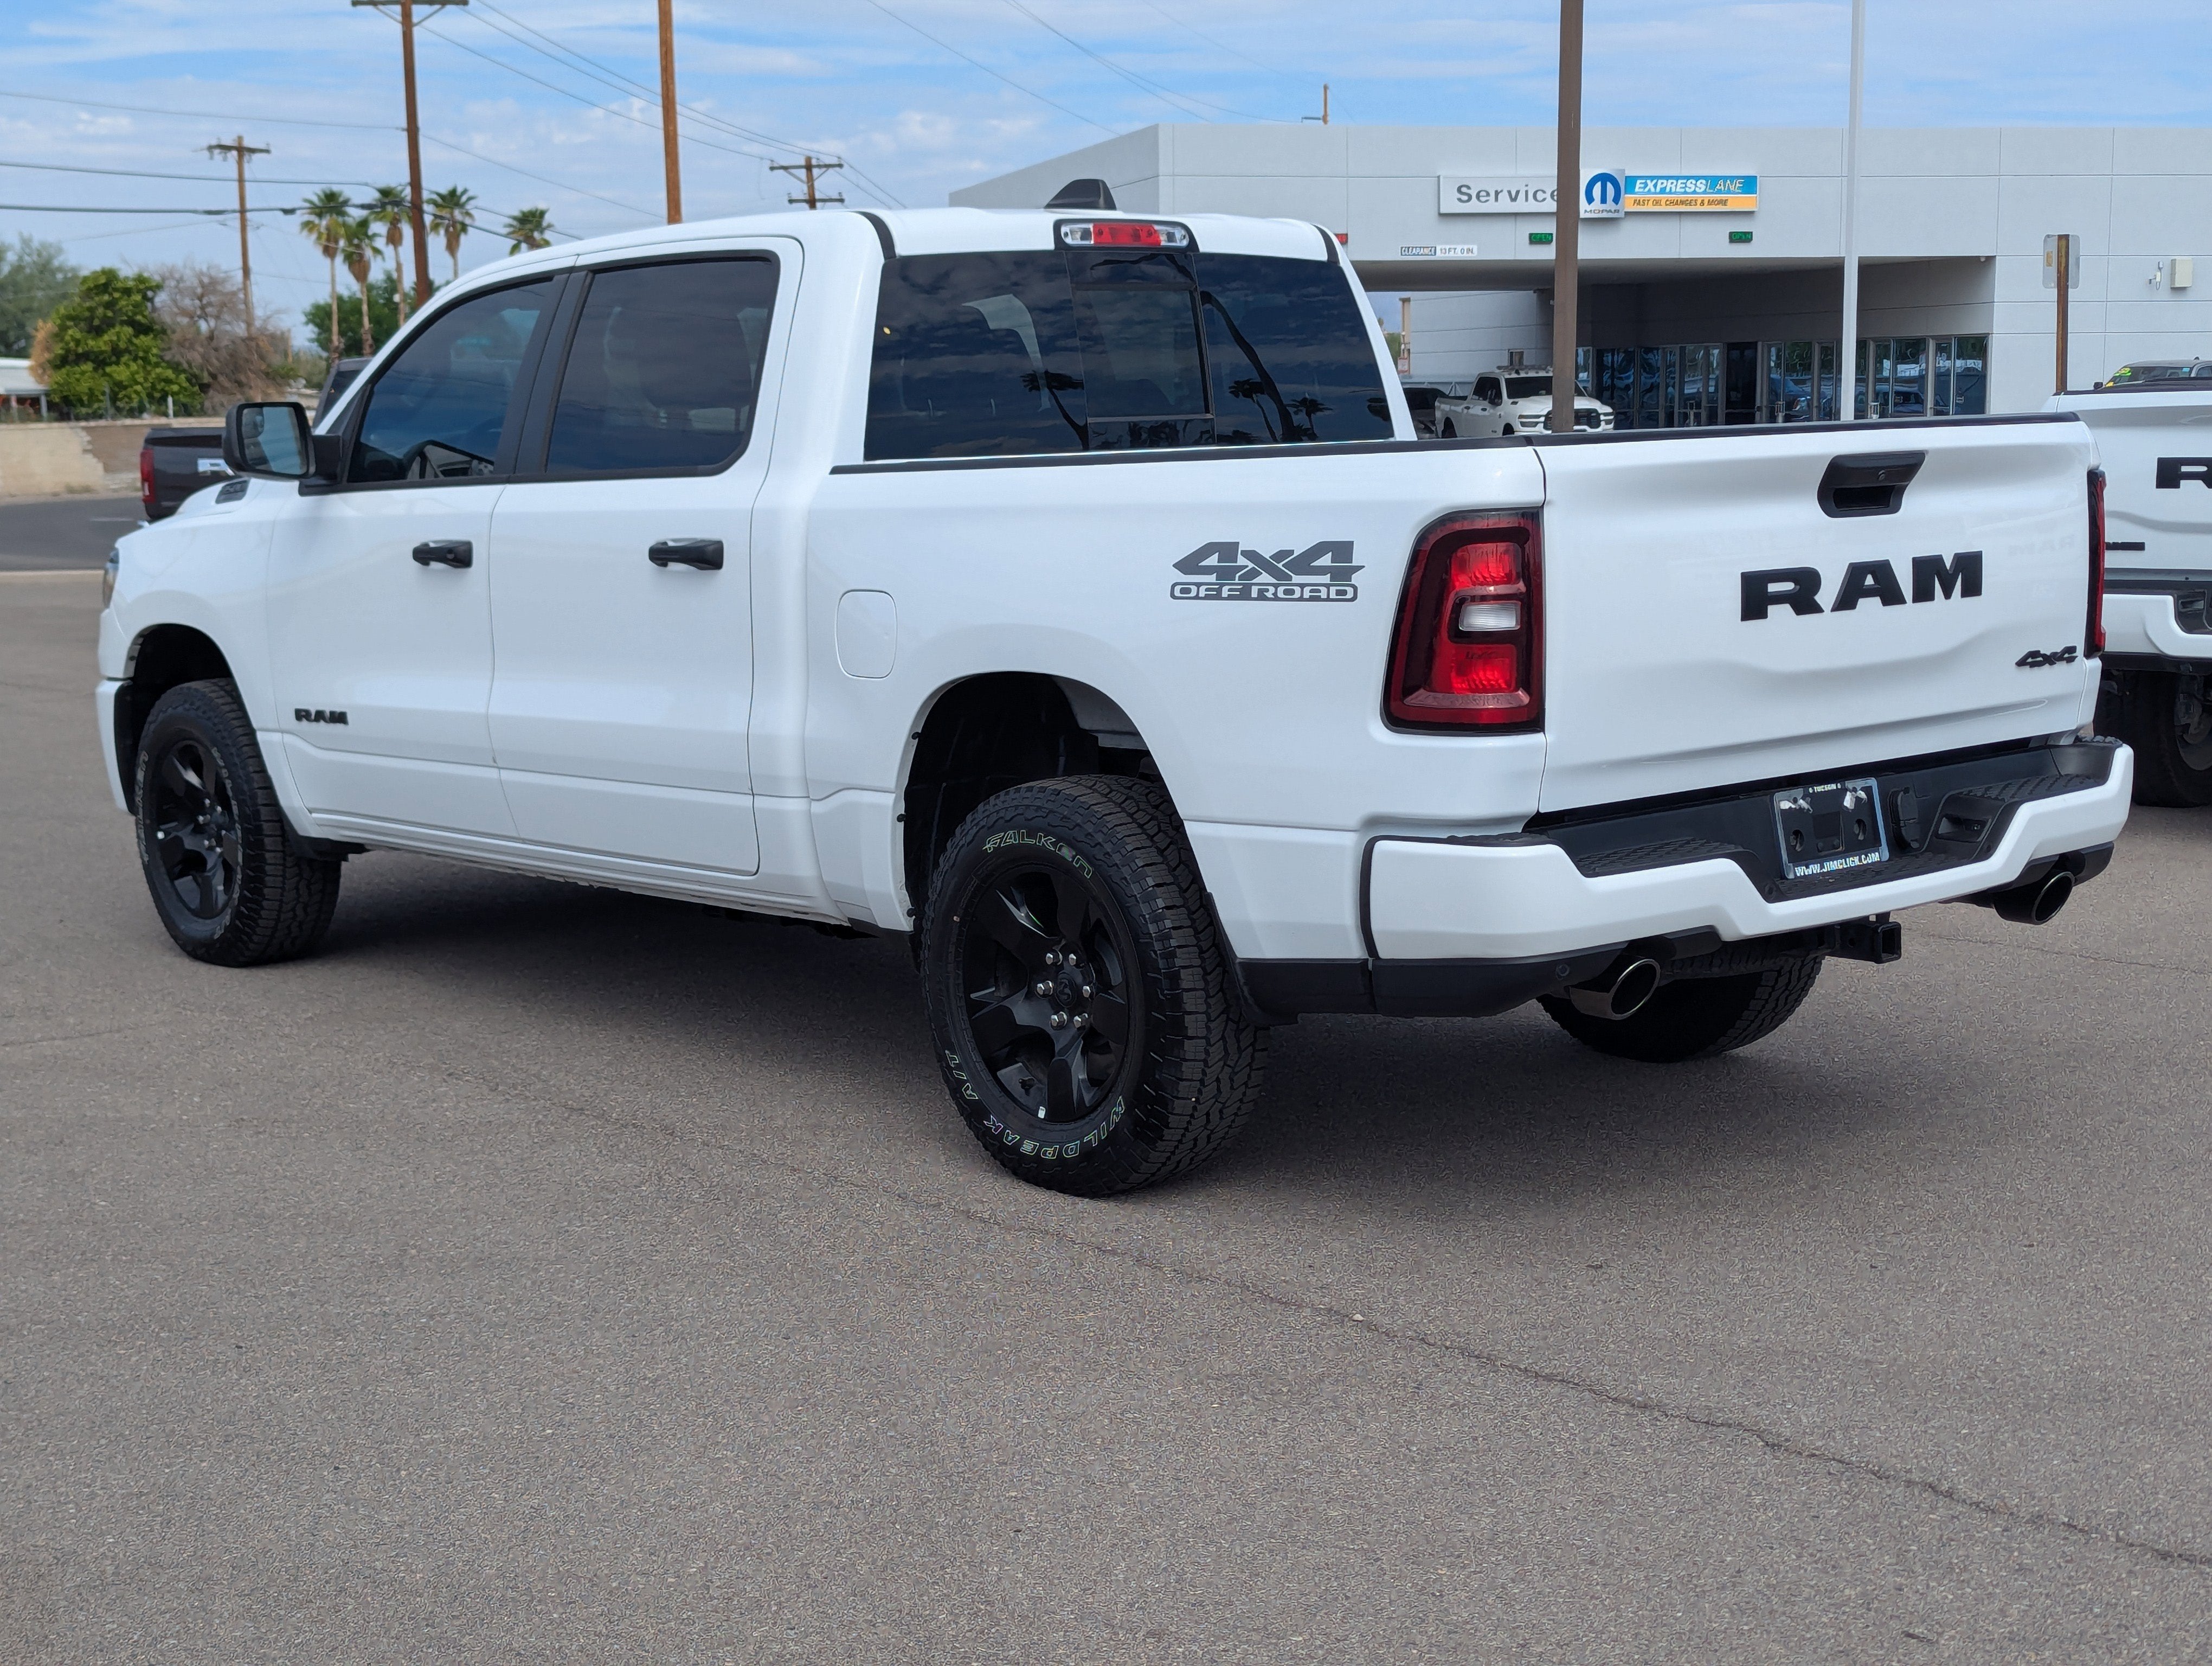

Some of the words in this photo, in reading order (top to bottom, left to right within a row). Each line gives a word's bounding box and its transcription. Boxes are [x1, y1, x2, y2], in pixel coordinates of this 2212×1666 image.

[1174, 585, 1243, 597] OFF
[1251, 586, 1354, 599] ROAD
[1741, 550, 1982, 621] RAM
[295, 708, 349, 725] RAM
[982, 830, 1093, 879] FALKEN
[983, 1095, 1125, 1159] WILDPEAK
